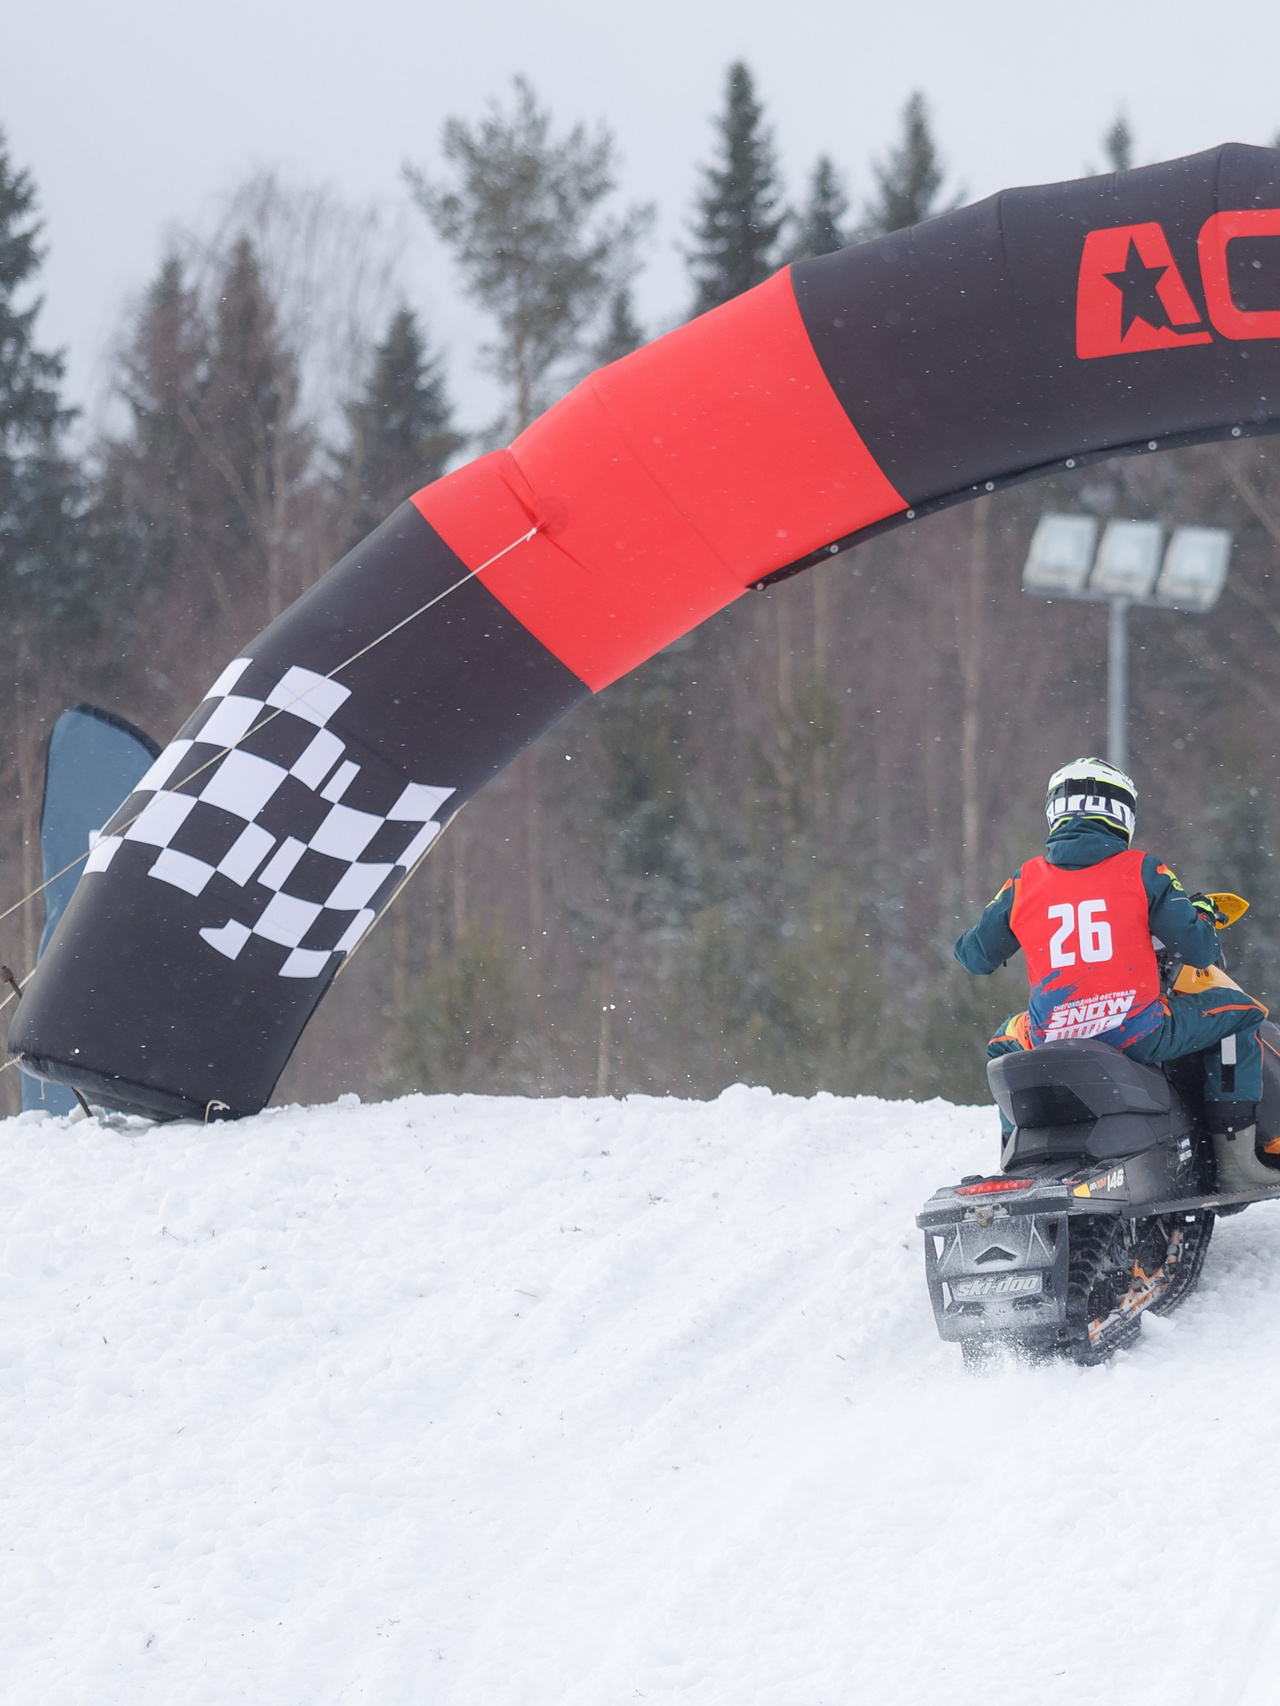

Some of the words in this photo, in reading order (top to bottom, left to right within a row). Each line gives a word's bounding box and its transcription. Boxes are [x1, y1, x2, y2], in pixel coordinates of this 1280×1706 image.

[1047, 899, 1113, 968] 26
[1053, 995, 1098, 1012] СНЕГОХОДНЫЙ
[1099, 989, 1137, 1001] ФЕСТИВАЛЬ
[1048, 996, 1135, 1029] SNOW
[1056, 1020, 1110, 1040] ПОМОРЬЕ
[1107, 1168, 1124, 1192] 146
[957, 1275, 1039, 1297] ski-doo
